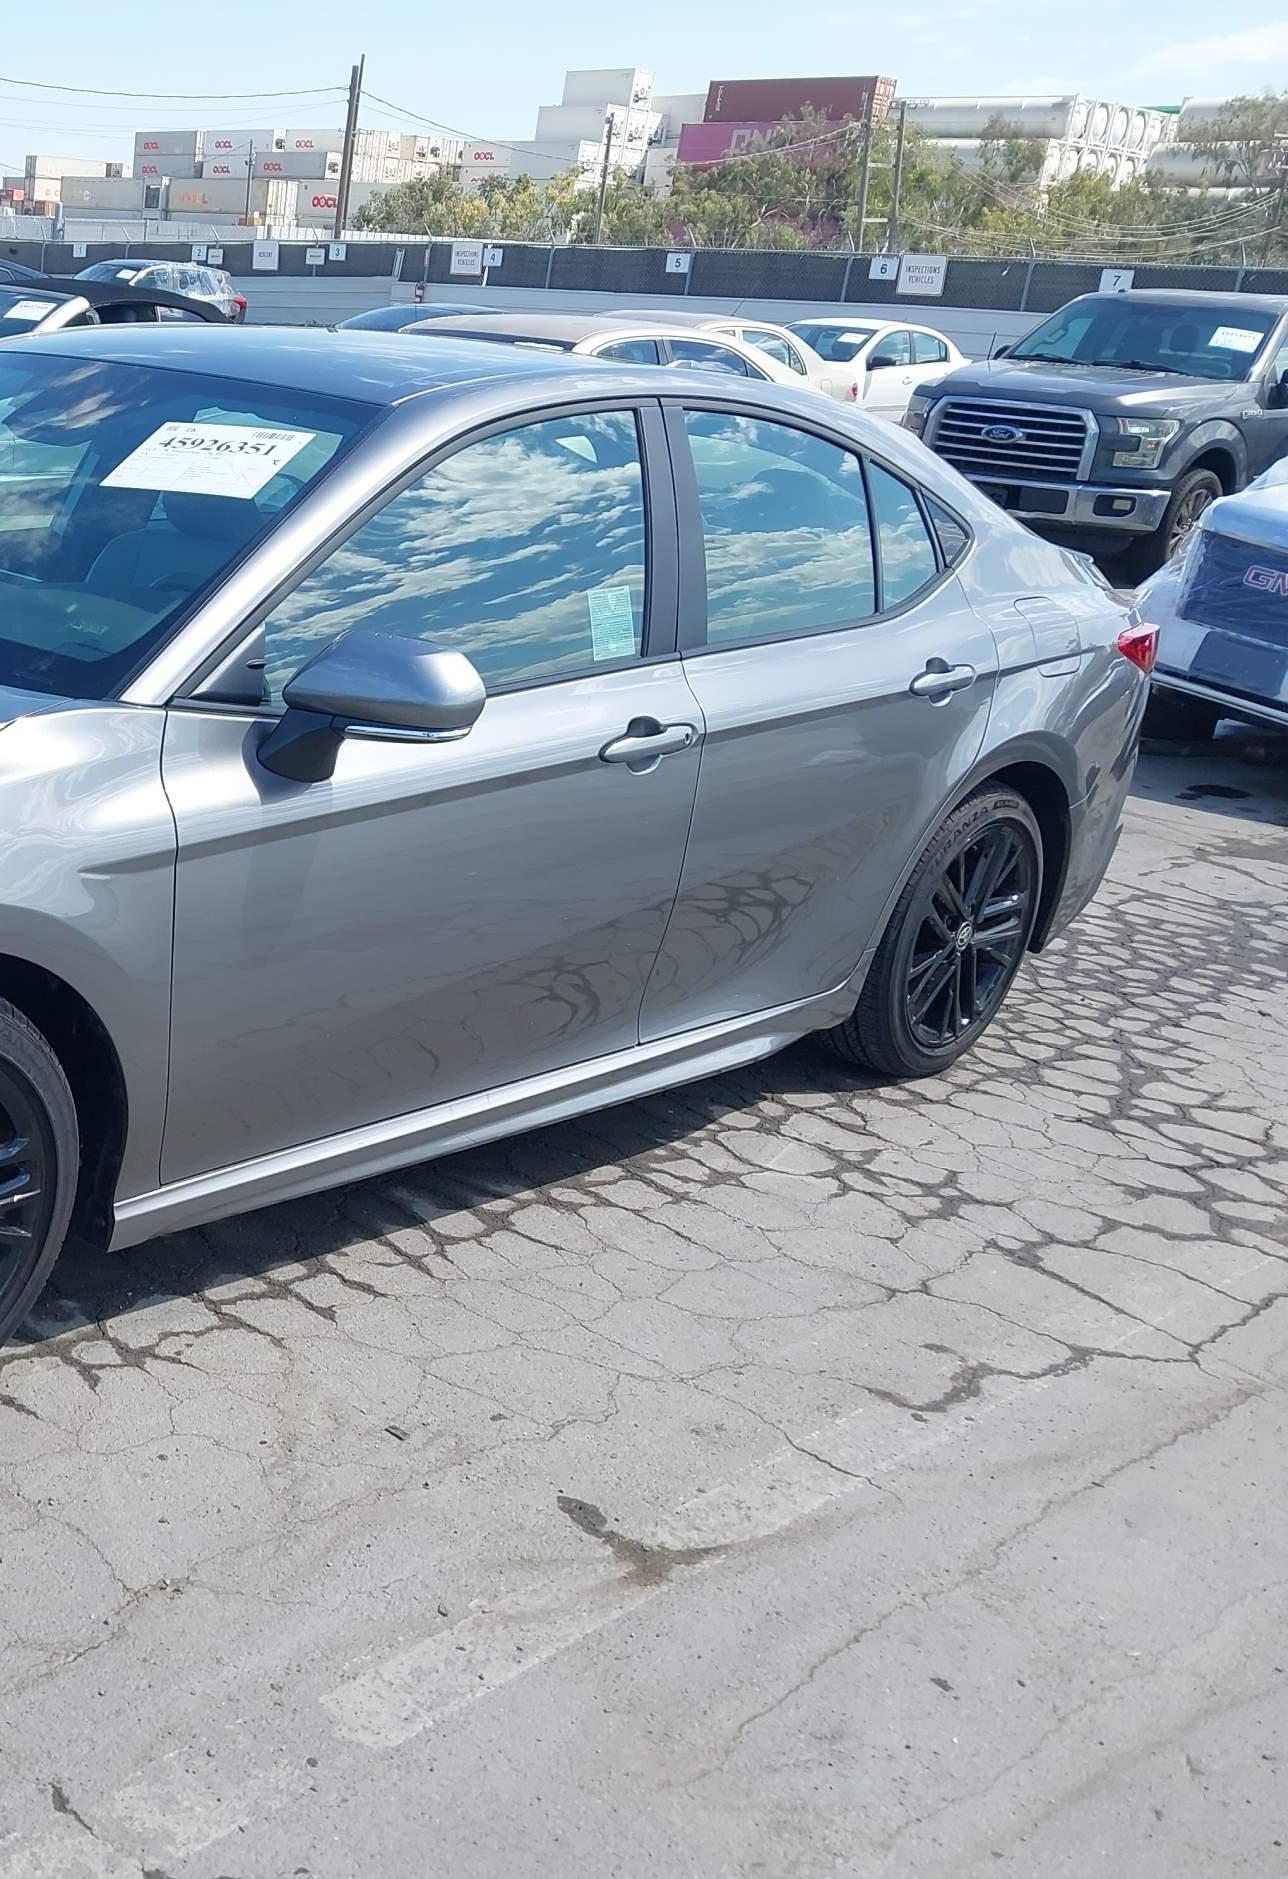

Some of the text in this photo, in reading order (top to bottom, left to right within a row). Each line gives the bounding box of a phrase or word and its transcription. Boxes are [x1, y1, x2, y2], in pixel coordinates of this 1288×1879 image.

[215, 140, 233, 149] OOCL
[295, 140, 314, 149] OOCL
[473, 151, 495, 161] OOCL
[213, 165, 231, 174] OOCL
[263, 162, 283, 172] OOCL
[674, 257, 682, 268] 5
[880, 263, 888, 274] 6
[904, 265, 941, 274] INSPECTIONS
[908, 275, 934, 284] VEHICLES
[1113, 275, 1121, 287] 7
[158, 436, 278, 456] 45926351
